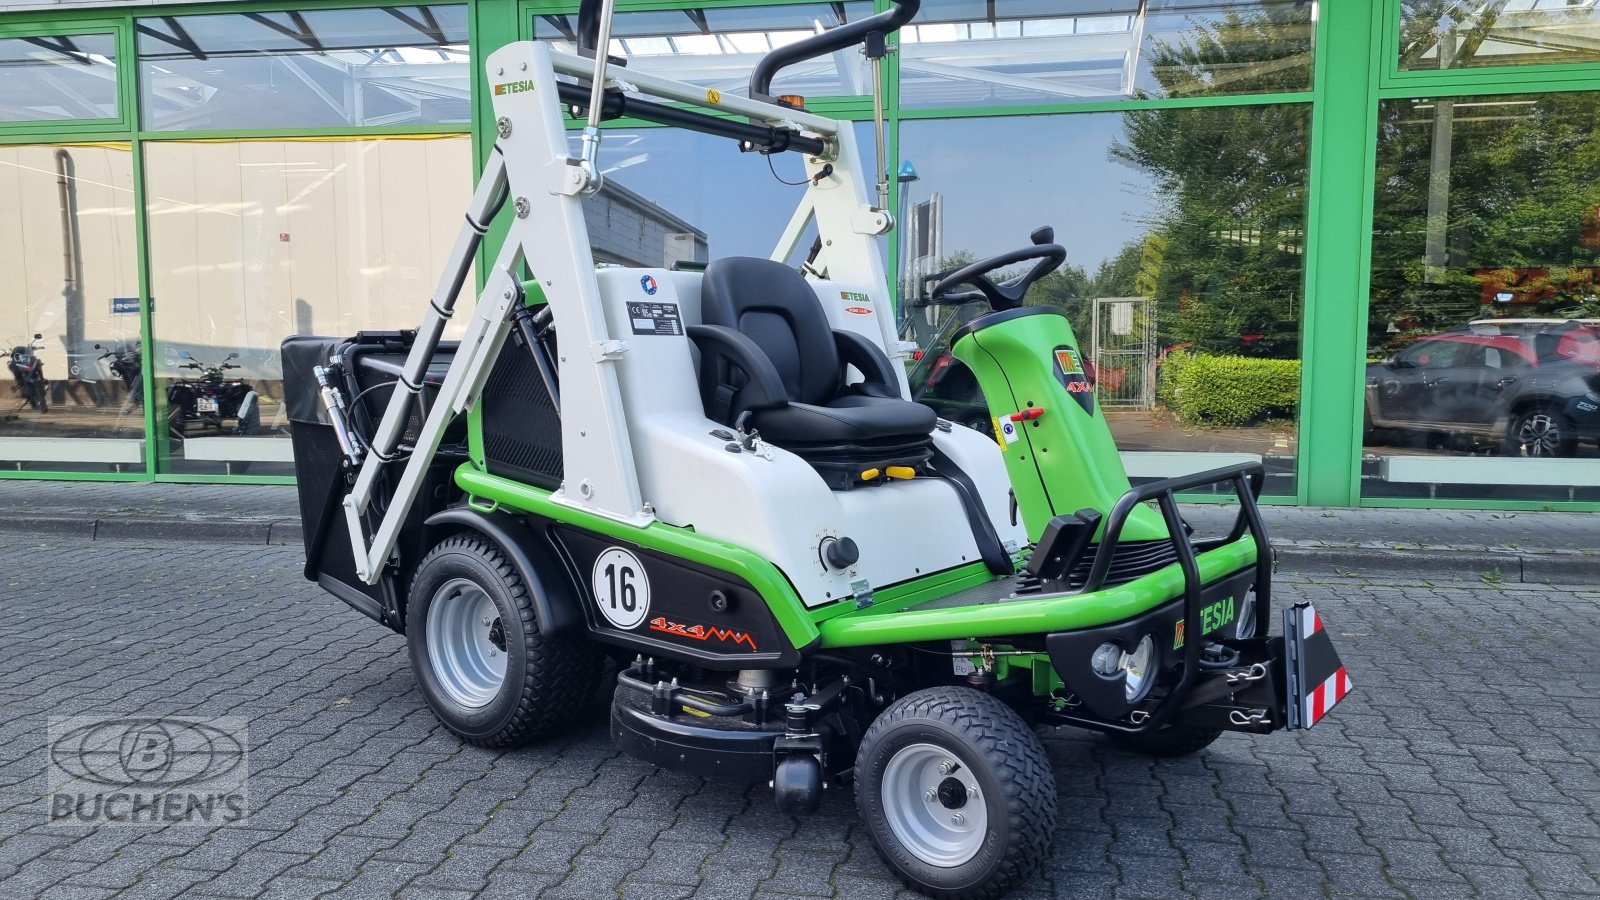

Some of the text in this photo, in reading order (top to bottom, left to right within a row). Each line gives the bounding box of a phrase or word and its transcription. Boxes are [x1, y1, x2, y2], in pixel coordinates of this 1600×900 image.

[495, 80, 534, 96] ETESIA
[841, 291, 870, 302] ETESIA
[604, 563, 636, 612] 16
[650, 617, 705, 637] 4x4
